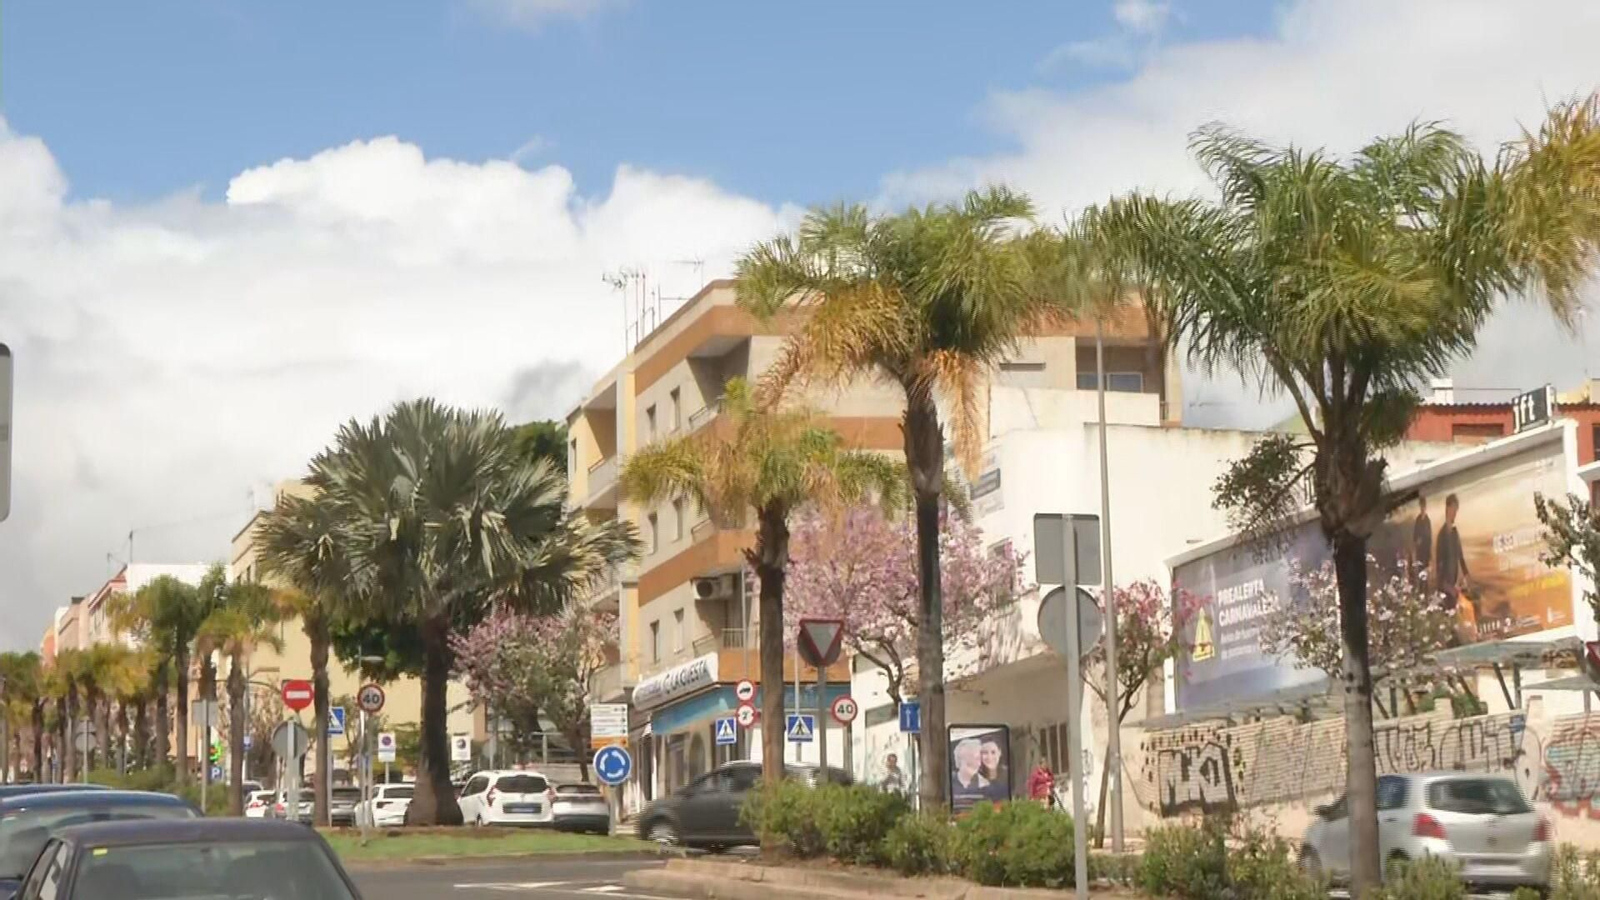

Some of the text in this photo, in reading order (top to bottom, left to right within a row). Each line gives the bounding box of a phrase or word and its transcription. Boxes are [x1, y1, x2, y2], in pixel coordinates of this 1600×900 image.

[1217, 577, 1265, 607] PREALERTA
[362, 693, 380, 705] 40
[837, 703, 854, 714] 40
[210, 766, 221, 780] P
